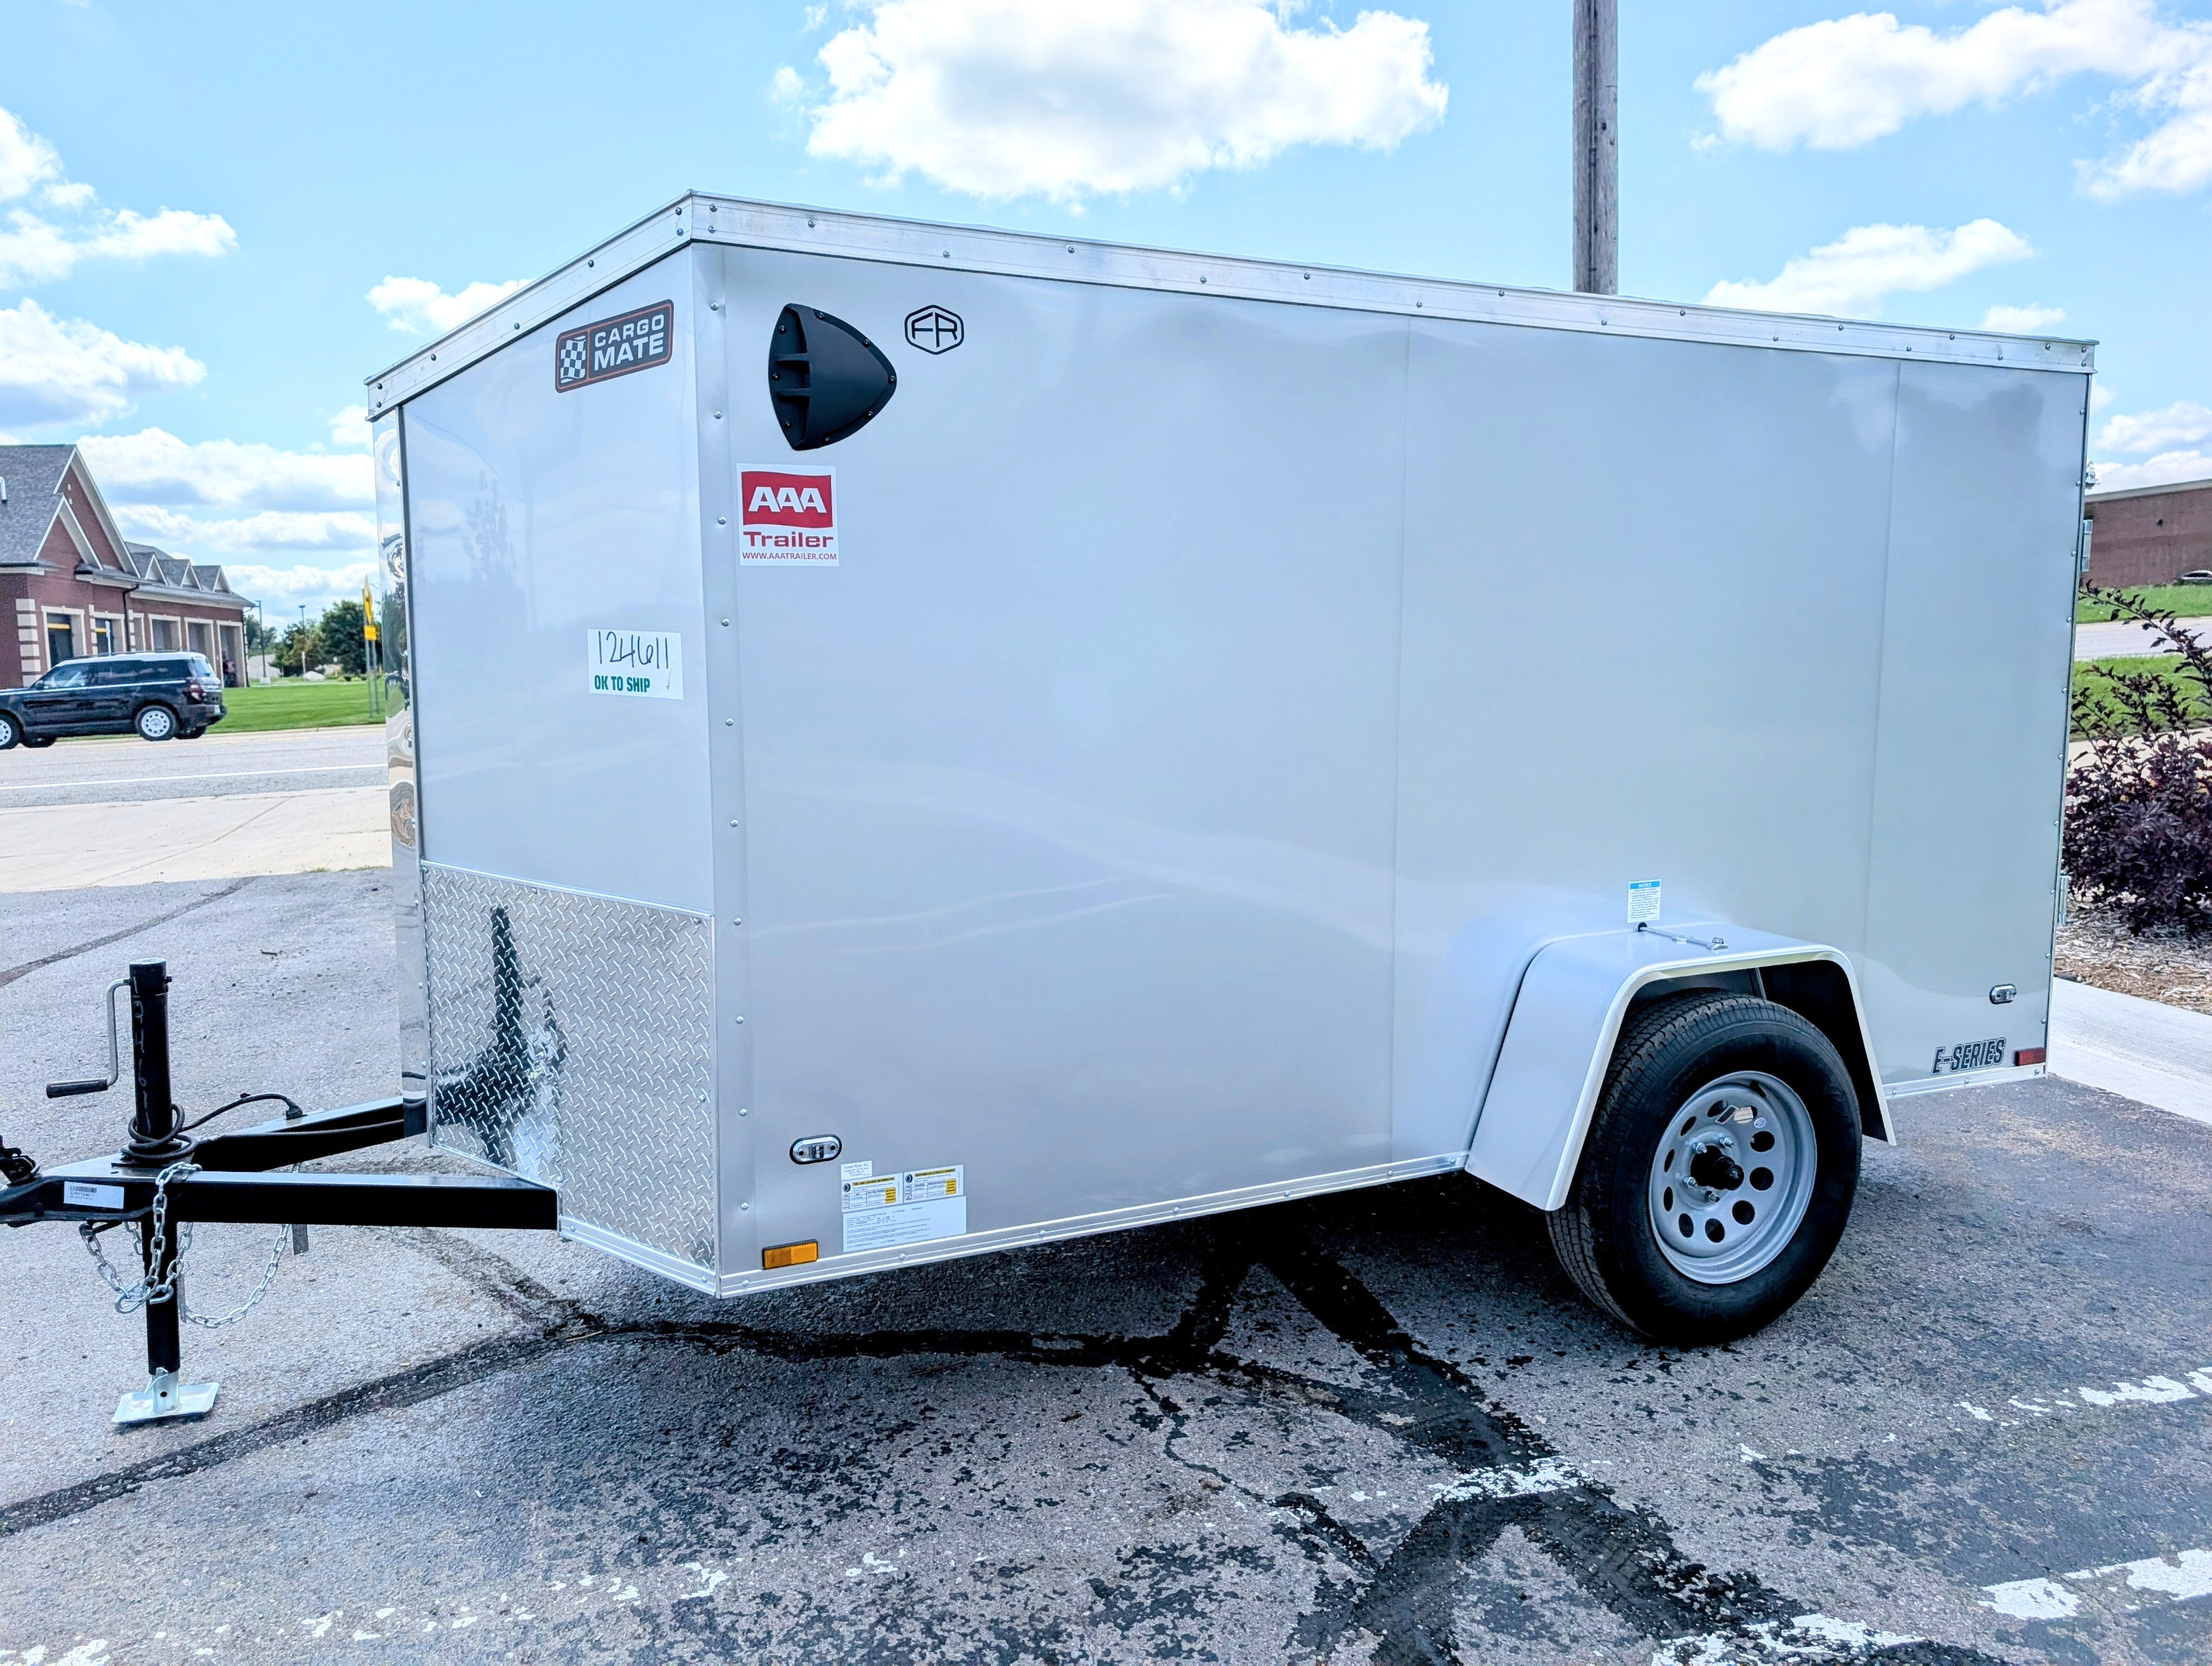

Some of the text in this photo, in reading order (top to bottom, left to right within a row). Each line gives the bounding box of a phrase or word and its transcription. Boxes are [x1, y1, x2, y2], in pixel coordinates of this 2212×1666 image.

[595, 314, 664, 347] CARGO
[594, 332, 664, 371] MATE
[748, 486, 827, 513] AAA
[743, 531, 834, 548] Trailer
[598, 631, 669, 669] 124611
[594, 675, 650, 693] OK TO SHIP
[1931, 1037, 2006, 1075] E-SERIES
